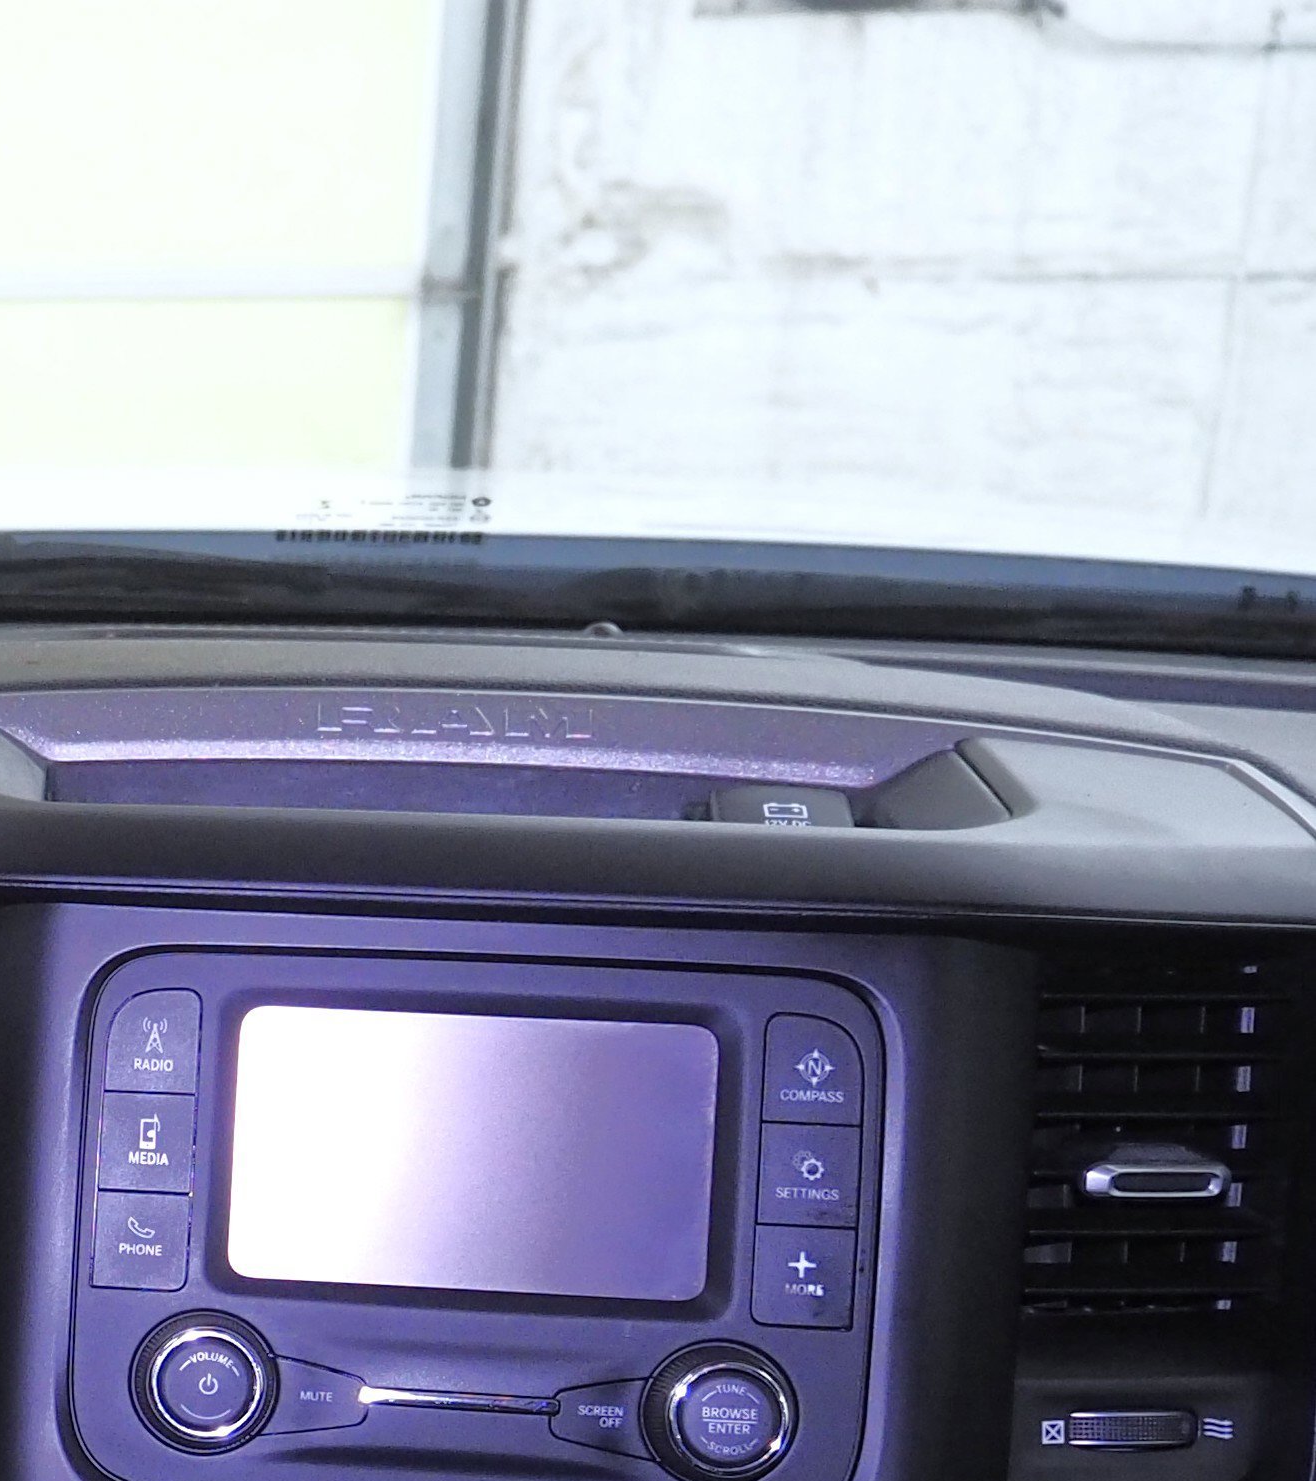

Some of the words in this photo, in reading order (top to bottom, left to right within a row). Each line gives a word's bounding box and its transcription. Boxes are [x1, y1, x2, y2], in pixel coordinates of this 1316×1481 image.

[133, 1057, 174, 1072] RADIO
[780, 1088, 844, 1103] COMPASS
[128, 1151, 169, 1166] MEDIA
[776, 1186, 840, 1201] SETTINGS
[119, 1242, 162, 1257] PHONE
[784, 1282, 825, 1297] MORE
[188, 1350, 234, 1369] VOLUME
[300, 1390, 334, 1402] MUTE
[715, 1383, 748, 1397] TUNE
[577, 1404, 625, 1417] SCREEN
[701, 1405, 759, 1421] BROWSE
[599, 1417, 624, 1429] OFF
[708, 1422, 752, 1435] ENTER
[706, 1439, 754, 1456] SCROLL
